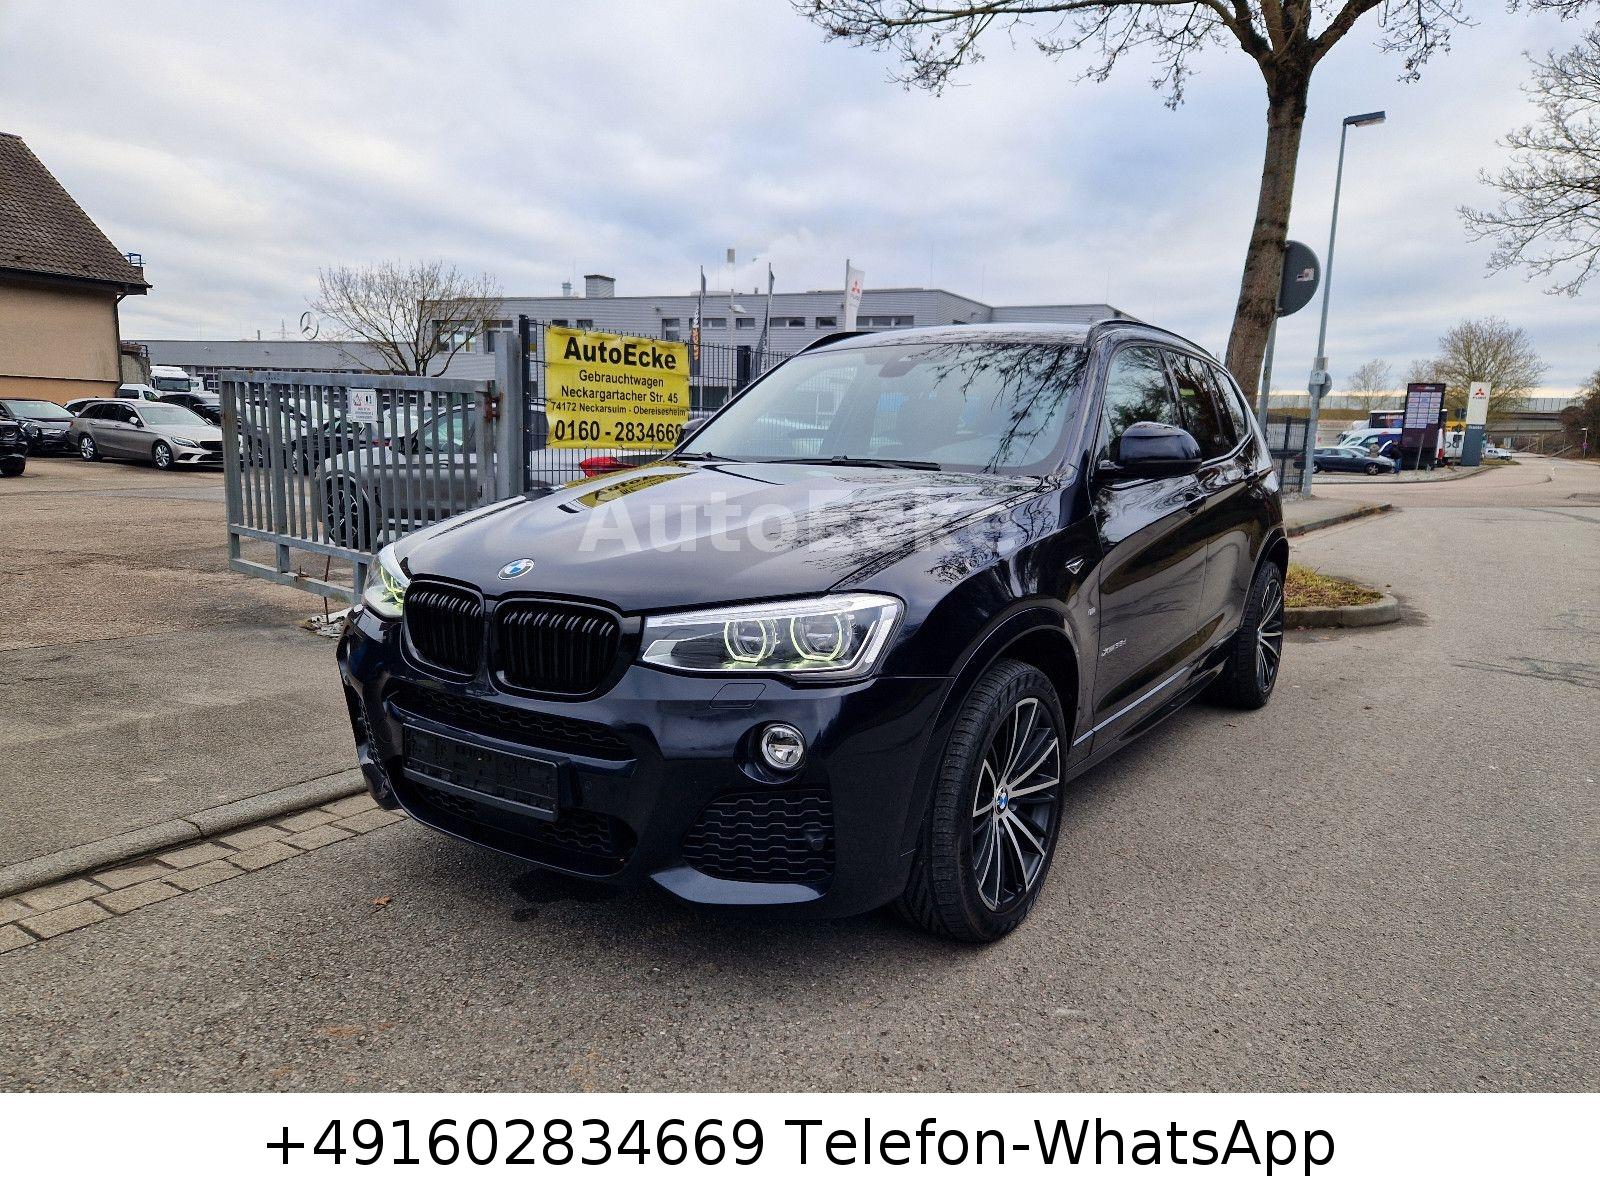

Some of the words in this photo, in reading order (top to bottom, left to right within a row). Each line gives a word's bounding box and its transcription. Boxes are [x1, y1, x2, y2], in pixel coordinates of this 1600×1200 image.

[564, 337, 676, 369] AutoEcke
[579, 369, 664, 389] Gebrauchtwagen
[561, 385, 647, 403] Neckargartacher
[649, 391, 665, 403] Str.
[667, 393, 678, 404] 45
[551, 402, 577, 412] 74172
[579, 403, 627, 414] Neckarsulm
[633, 405, 686, 416] Obereisesheim
[554, 419, 600, 441] 0160
